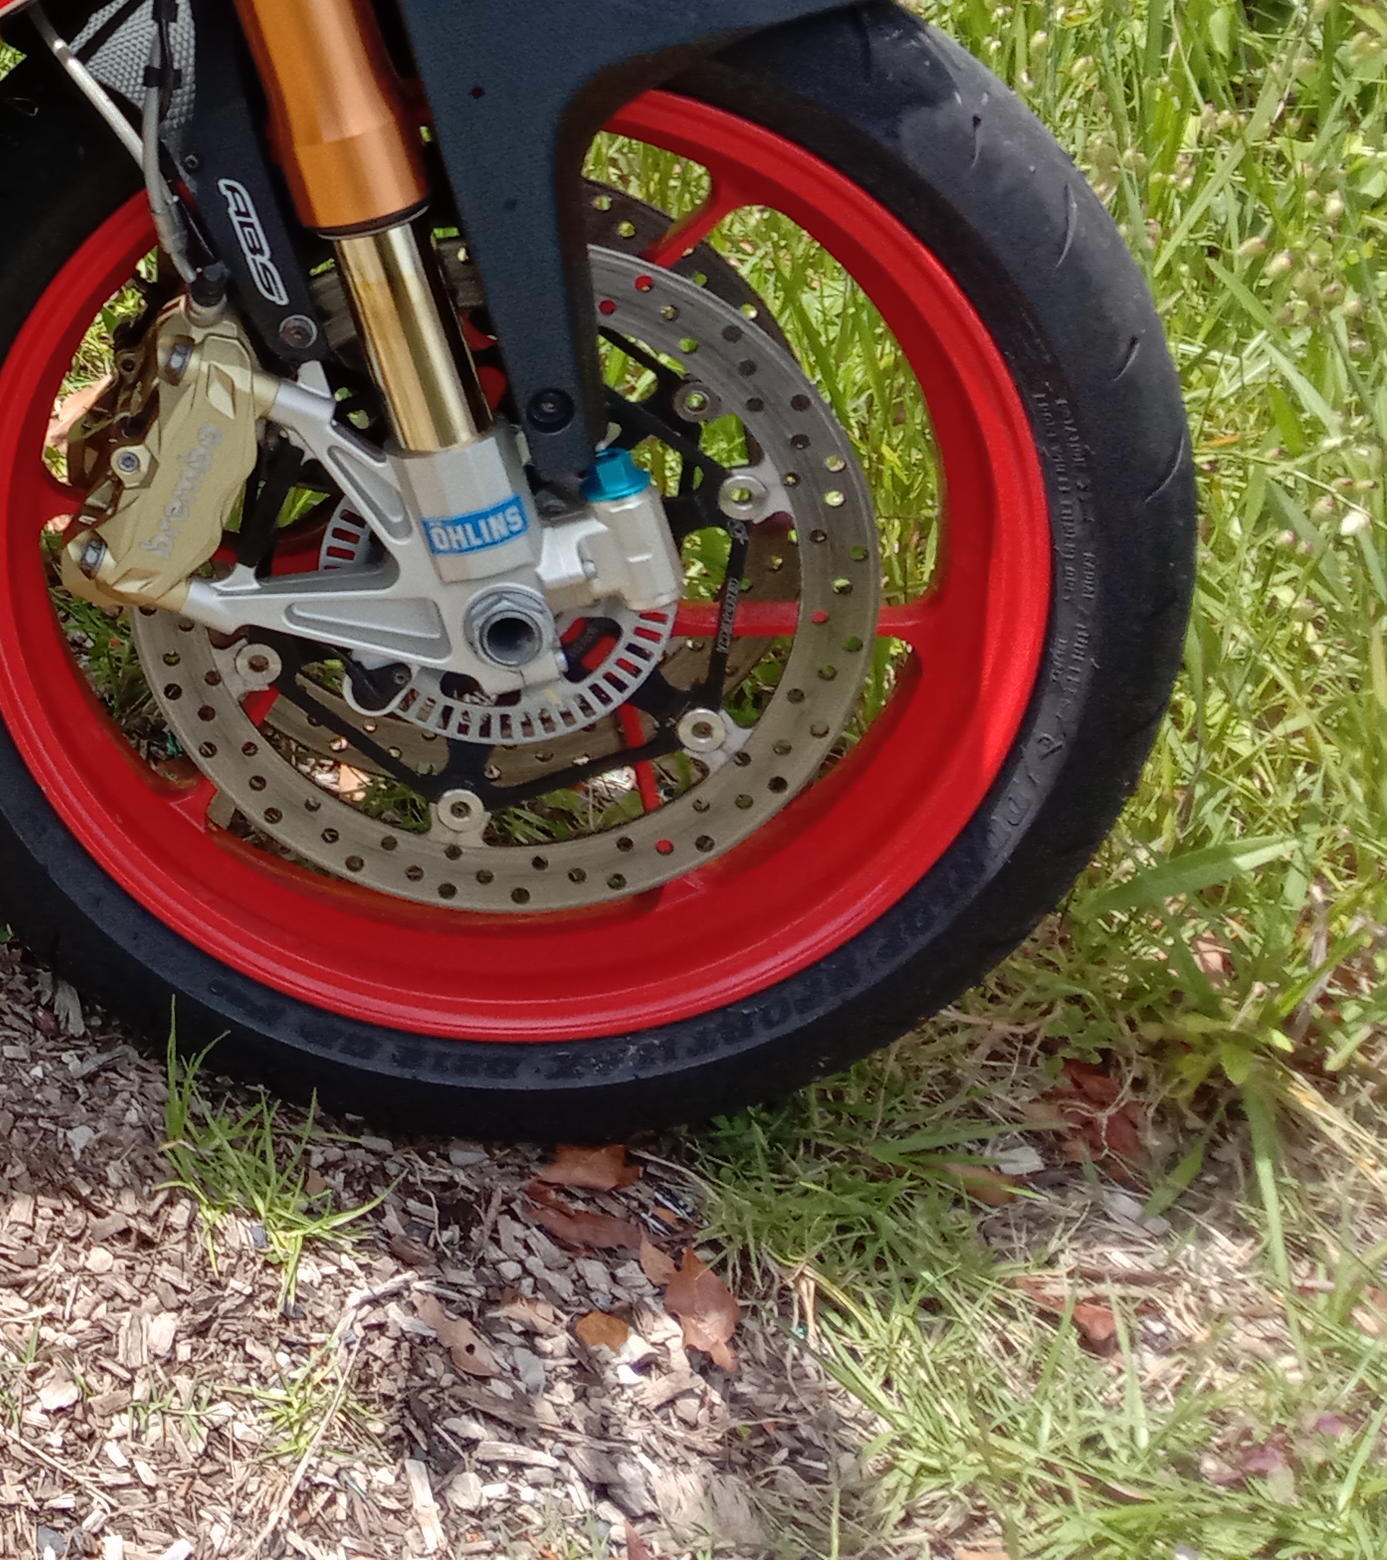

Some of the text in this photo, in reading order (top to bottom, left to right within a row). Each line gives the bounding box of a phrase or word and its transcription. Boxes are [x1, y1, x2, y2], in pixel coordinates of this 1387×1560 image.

[217, 178, 290, 306] ABS
[139, 423, 223, 559] brembo
[428, 505, 525, 551] ÖHLINS
